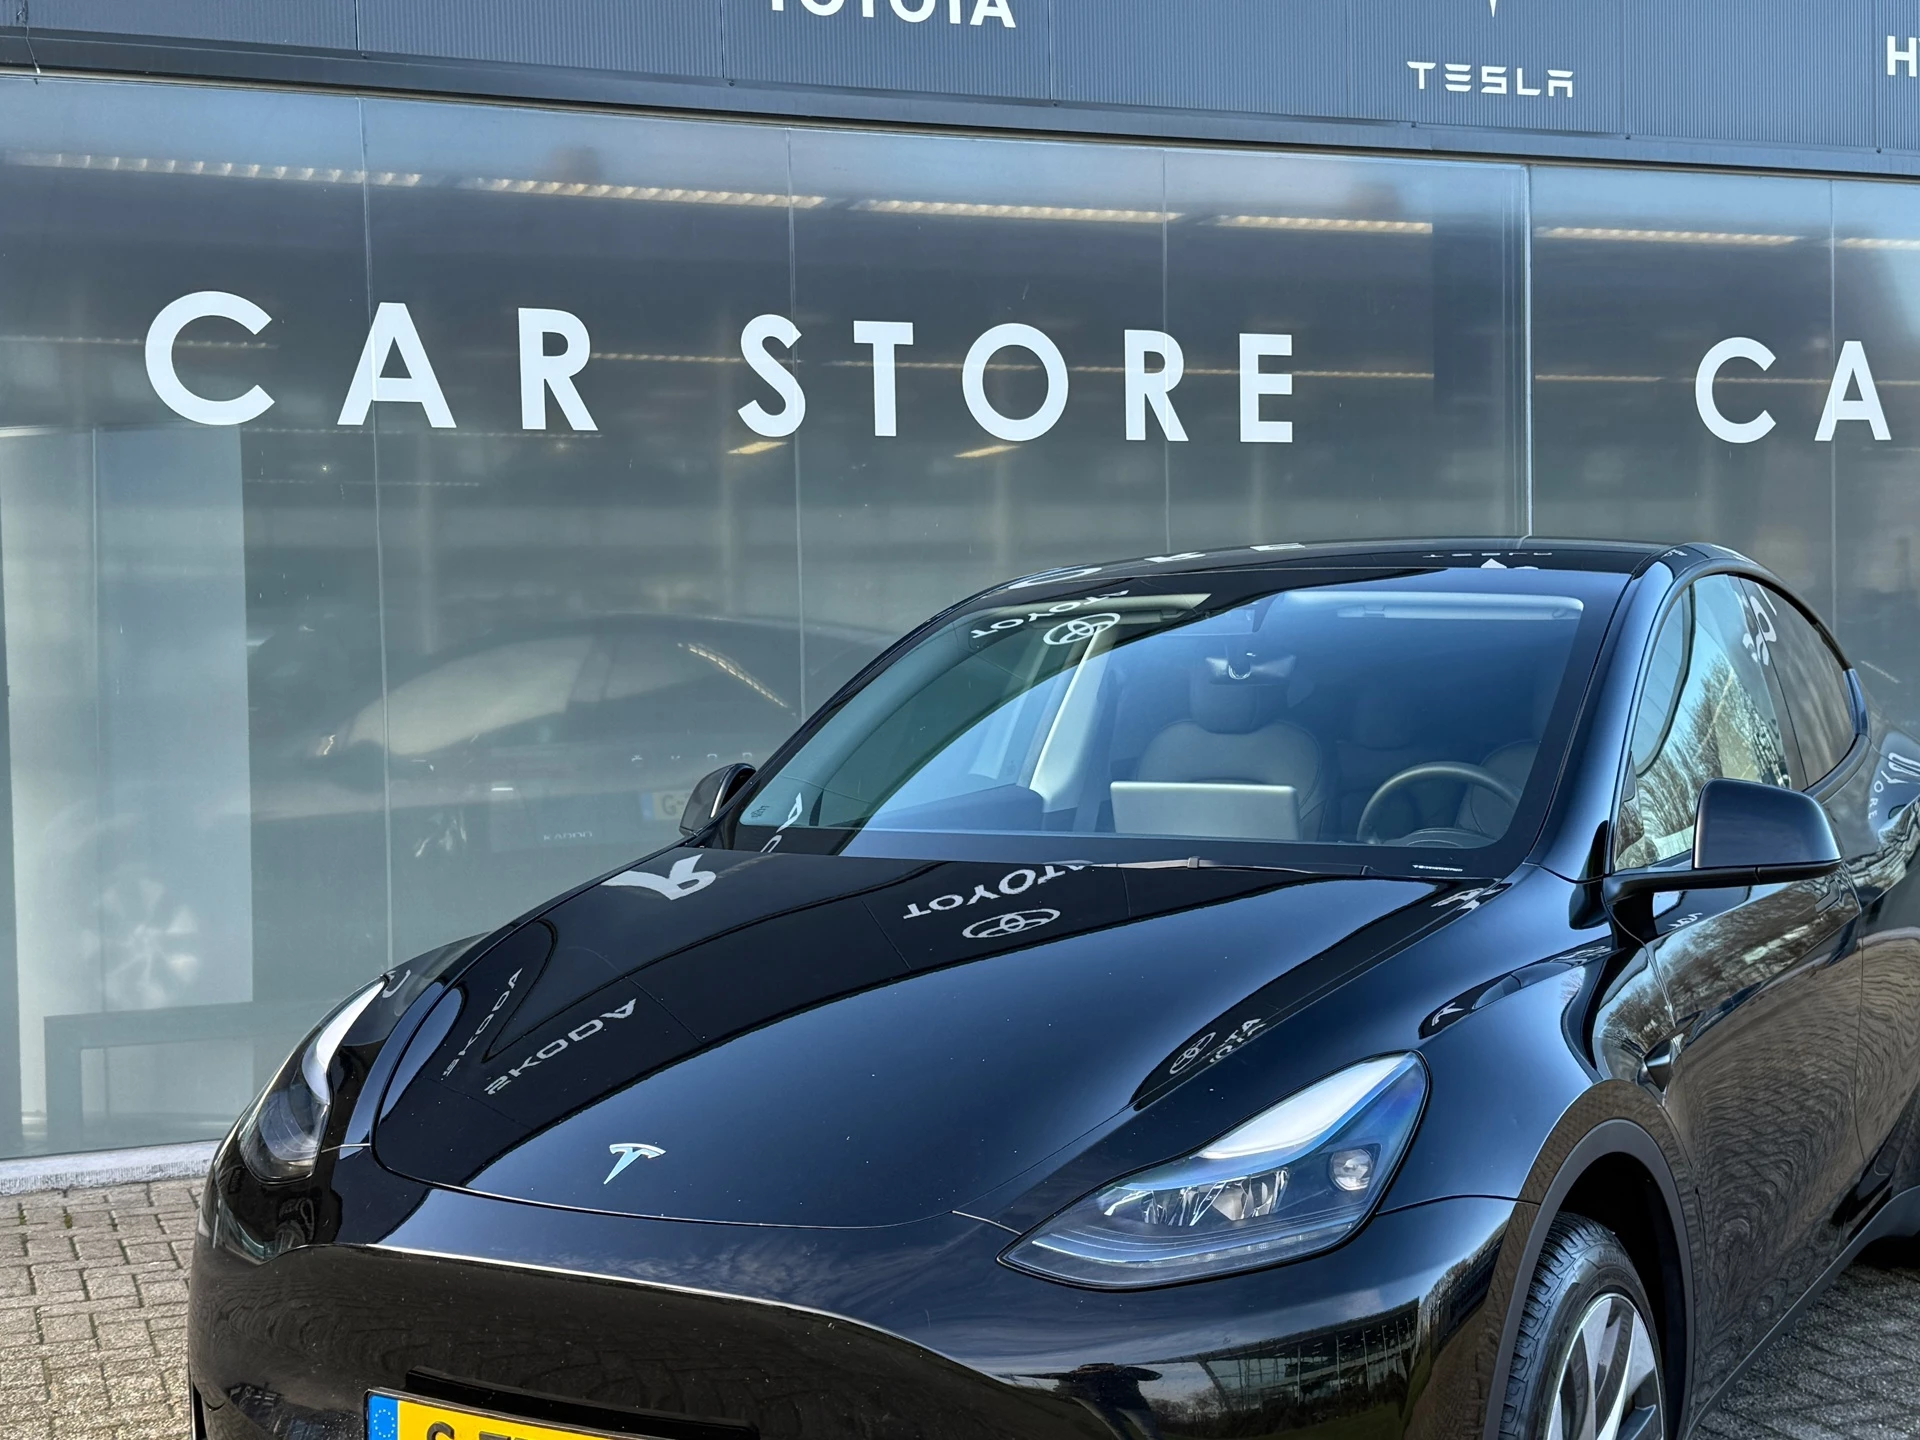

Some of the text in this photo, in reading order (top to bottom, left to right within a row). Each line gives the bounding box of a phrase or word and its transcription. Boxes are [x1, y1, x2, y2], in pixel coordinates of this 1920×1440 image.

[1406, 60, 1574, 98] TESLA
[1886, 35, 1920, 78] H
[144, 290, 1293, 443] CAR STORE
[1694, 336, 1892, 444] CA
